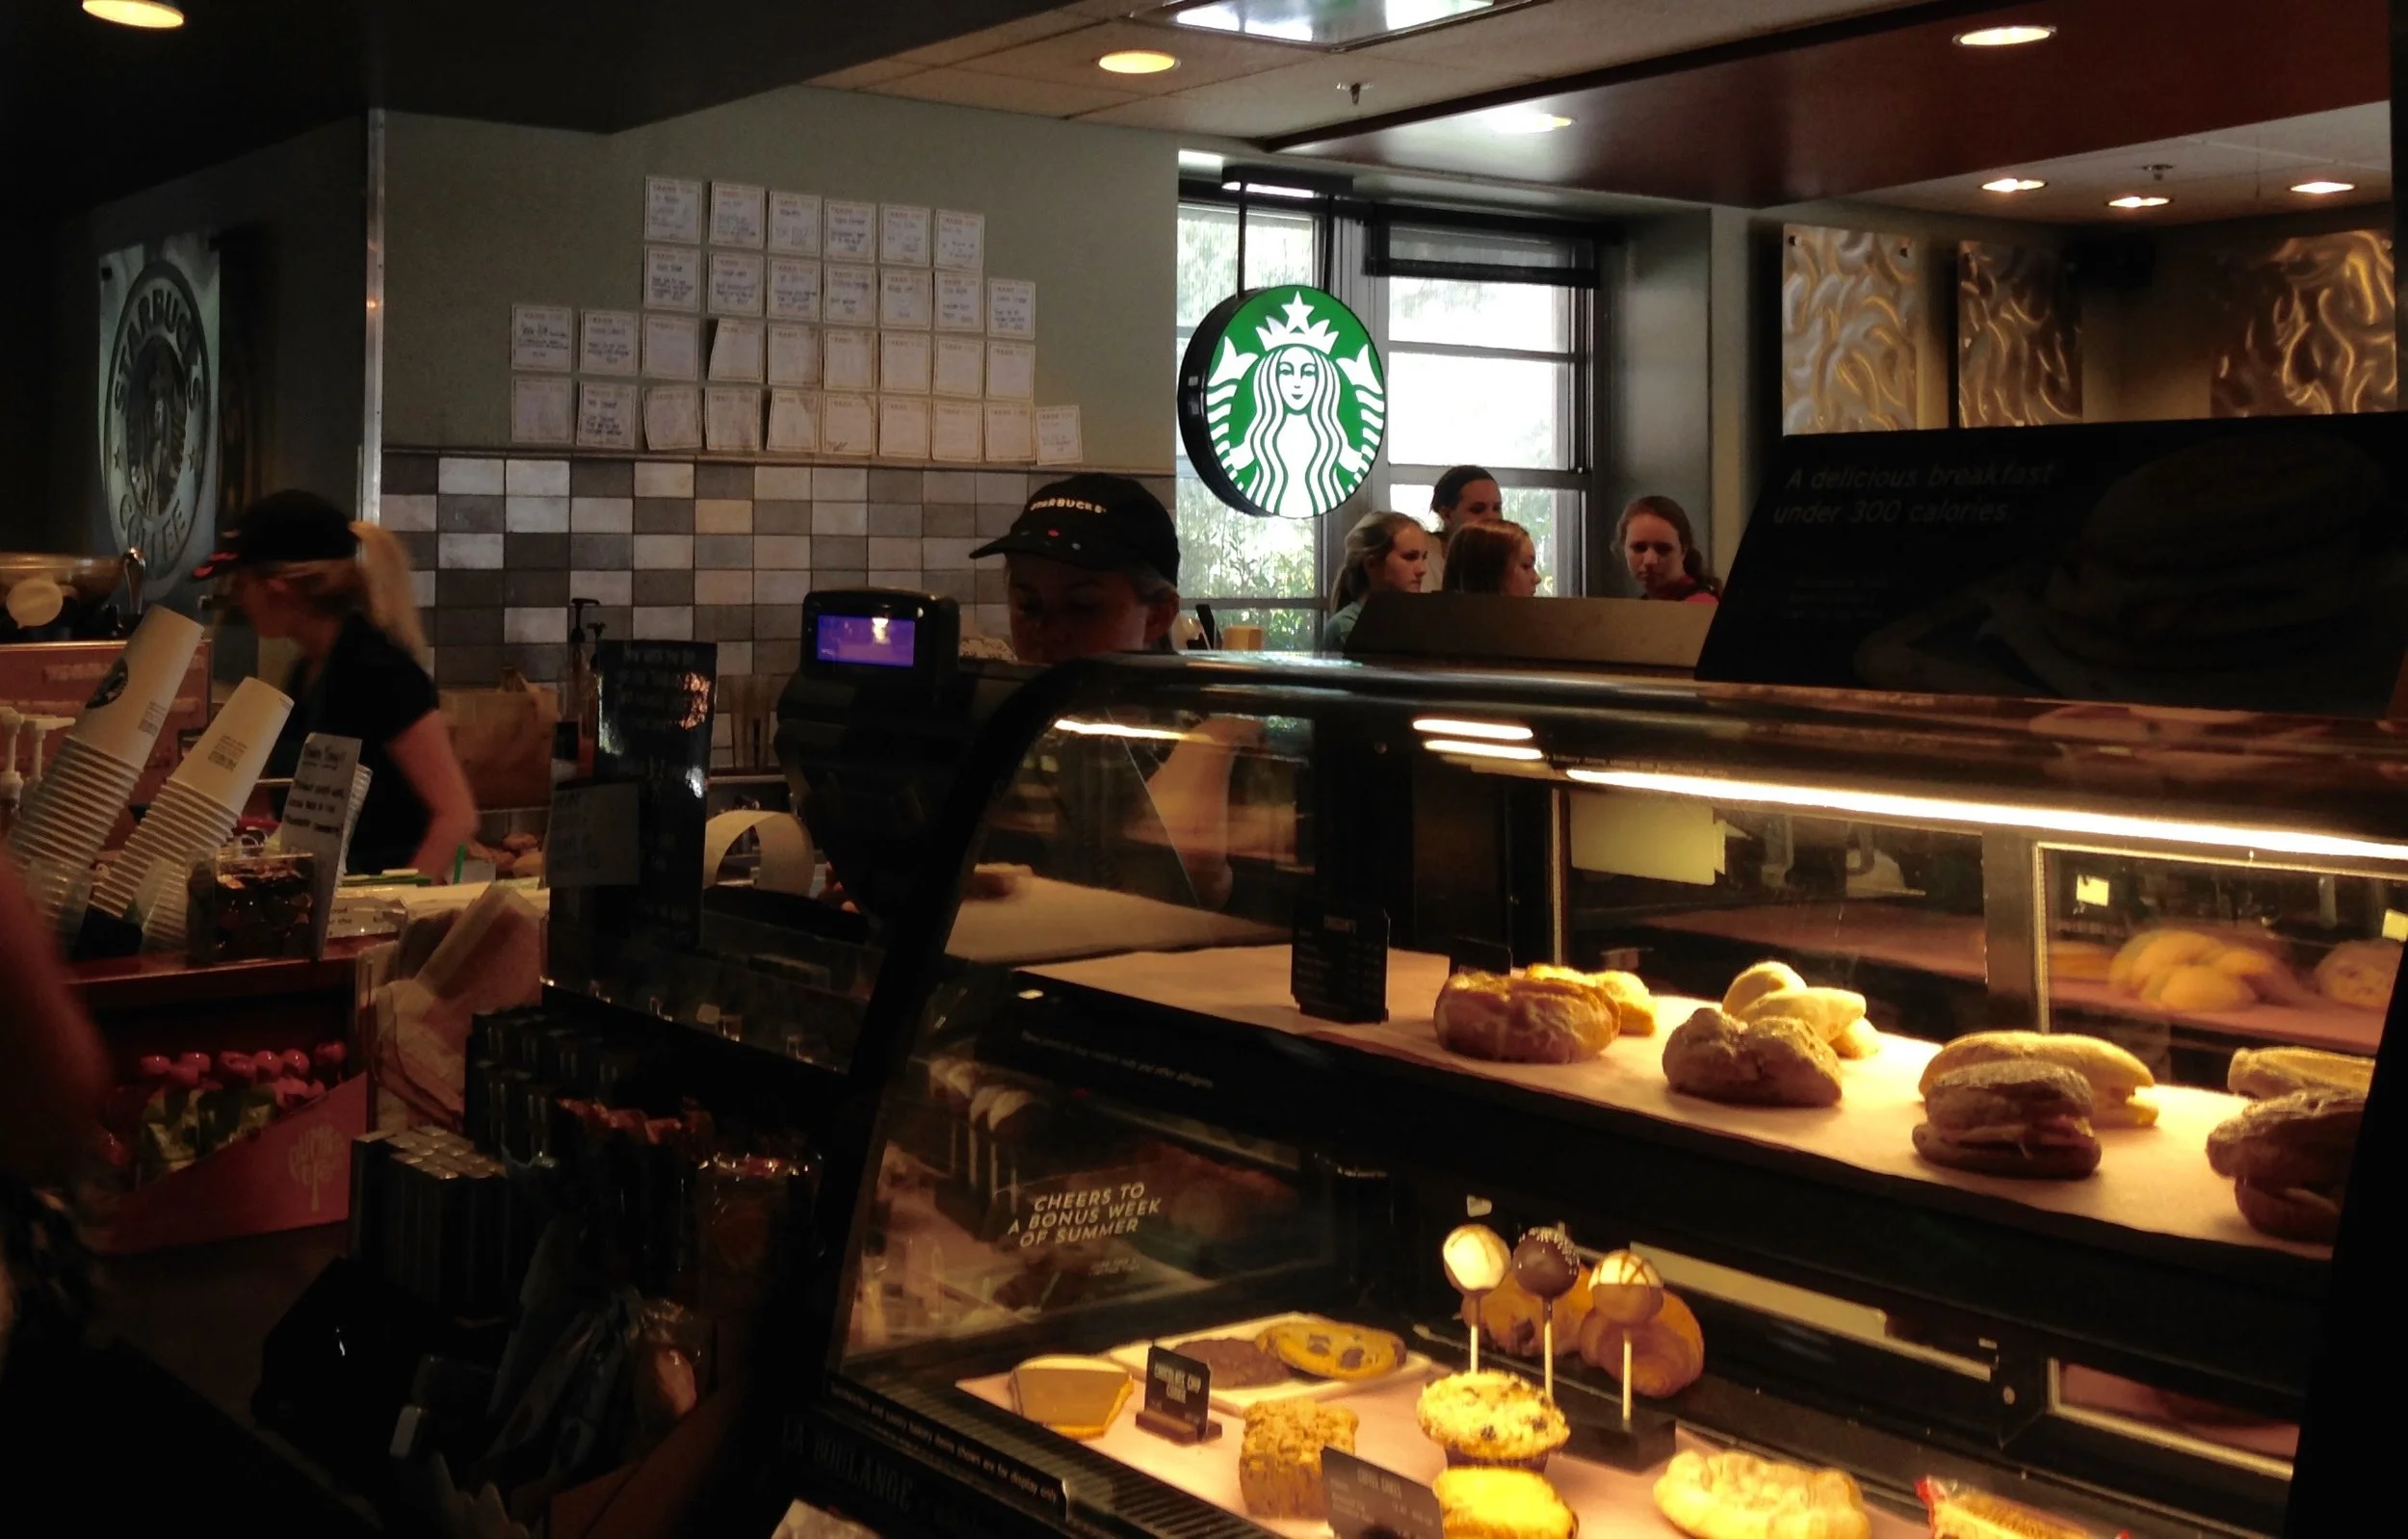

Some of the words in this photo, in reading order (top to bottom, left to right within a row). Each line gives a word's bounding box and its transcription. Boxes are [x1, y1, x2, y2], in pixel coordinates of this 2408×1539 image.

[1784, 466, 1804, 489] A
[1811, 463, 1919, 489] delicious
[1926, 458, 2057, 487] breakfast
[1772, 502, 1842, 525] under
[1848, 499, 1903, 524] 300
[1034, 1186, 1112, 1213] CHEERS
[1119, 1181, 1146, 1201] TO
[1008, 1218, 1020, 1236] A
[1029, 1208, 1100, 1231] BONUS
[1108, 1197, 1162, 1219] WEEK
[1019, 1228, 1049, 1248] OF
[1055, 1216, 1139, 1244] SUMMER
